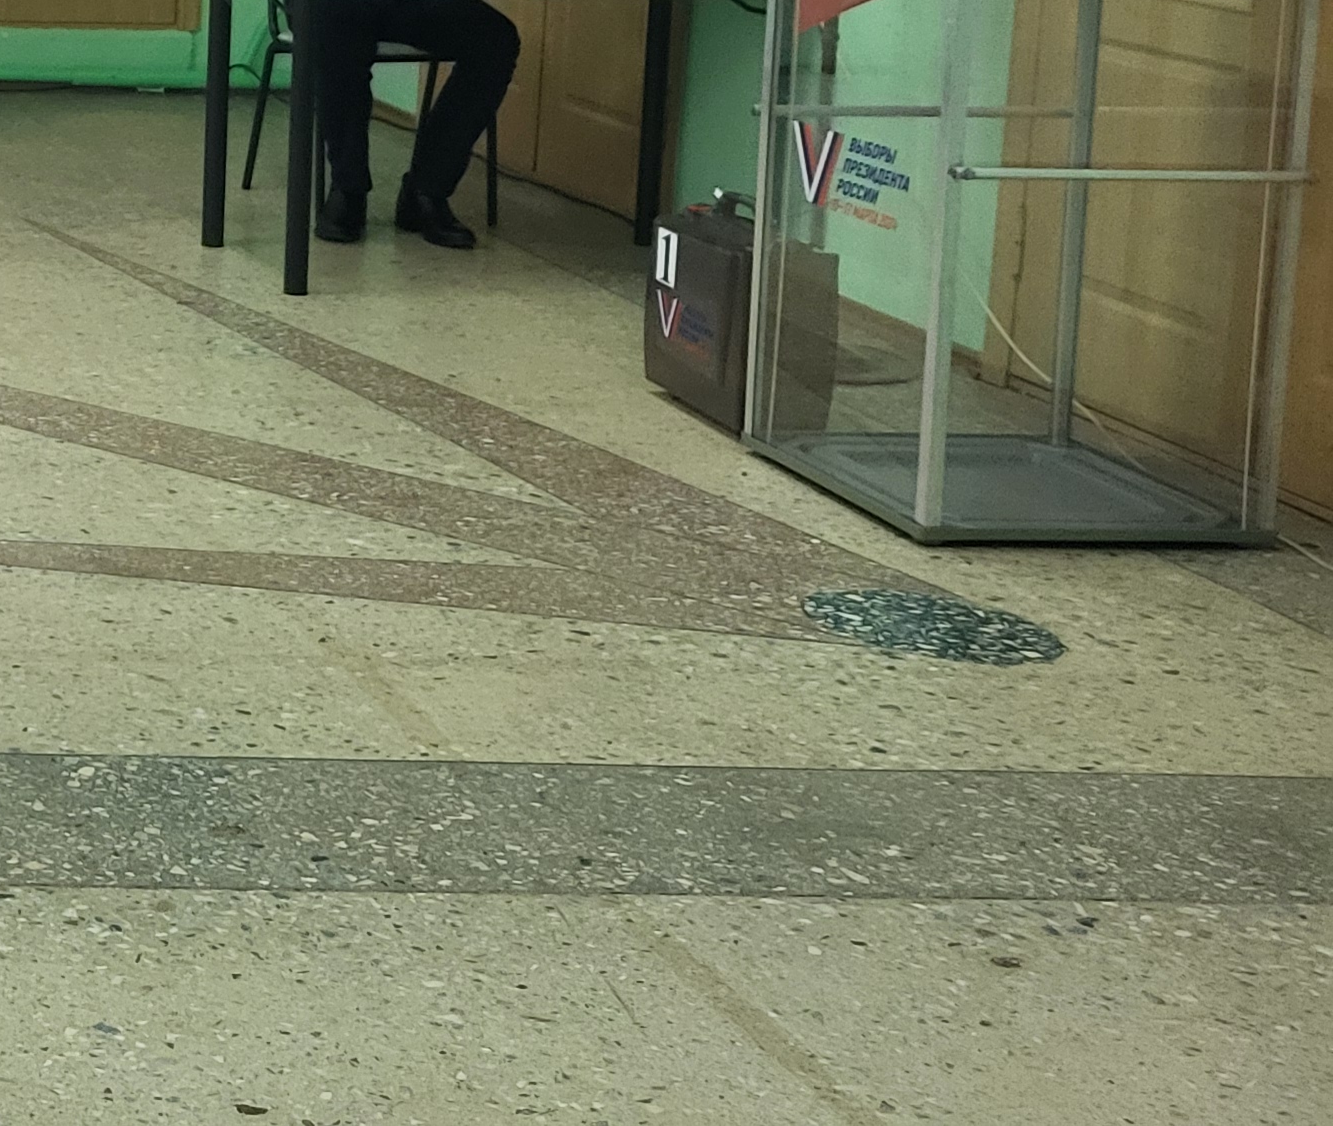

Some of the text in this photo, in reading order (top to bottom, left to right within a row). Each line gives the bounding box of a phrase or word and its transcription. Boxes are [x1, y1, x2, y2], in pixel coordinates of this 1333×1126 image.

[848, 137, 898, 165] ВЫБОРЫ
[842, 158, 910, 193] ПРЕЗИДЕНТА
[836, 179, 880, 205] РОССИИ
